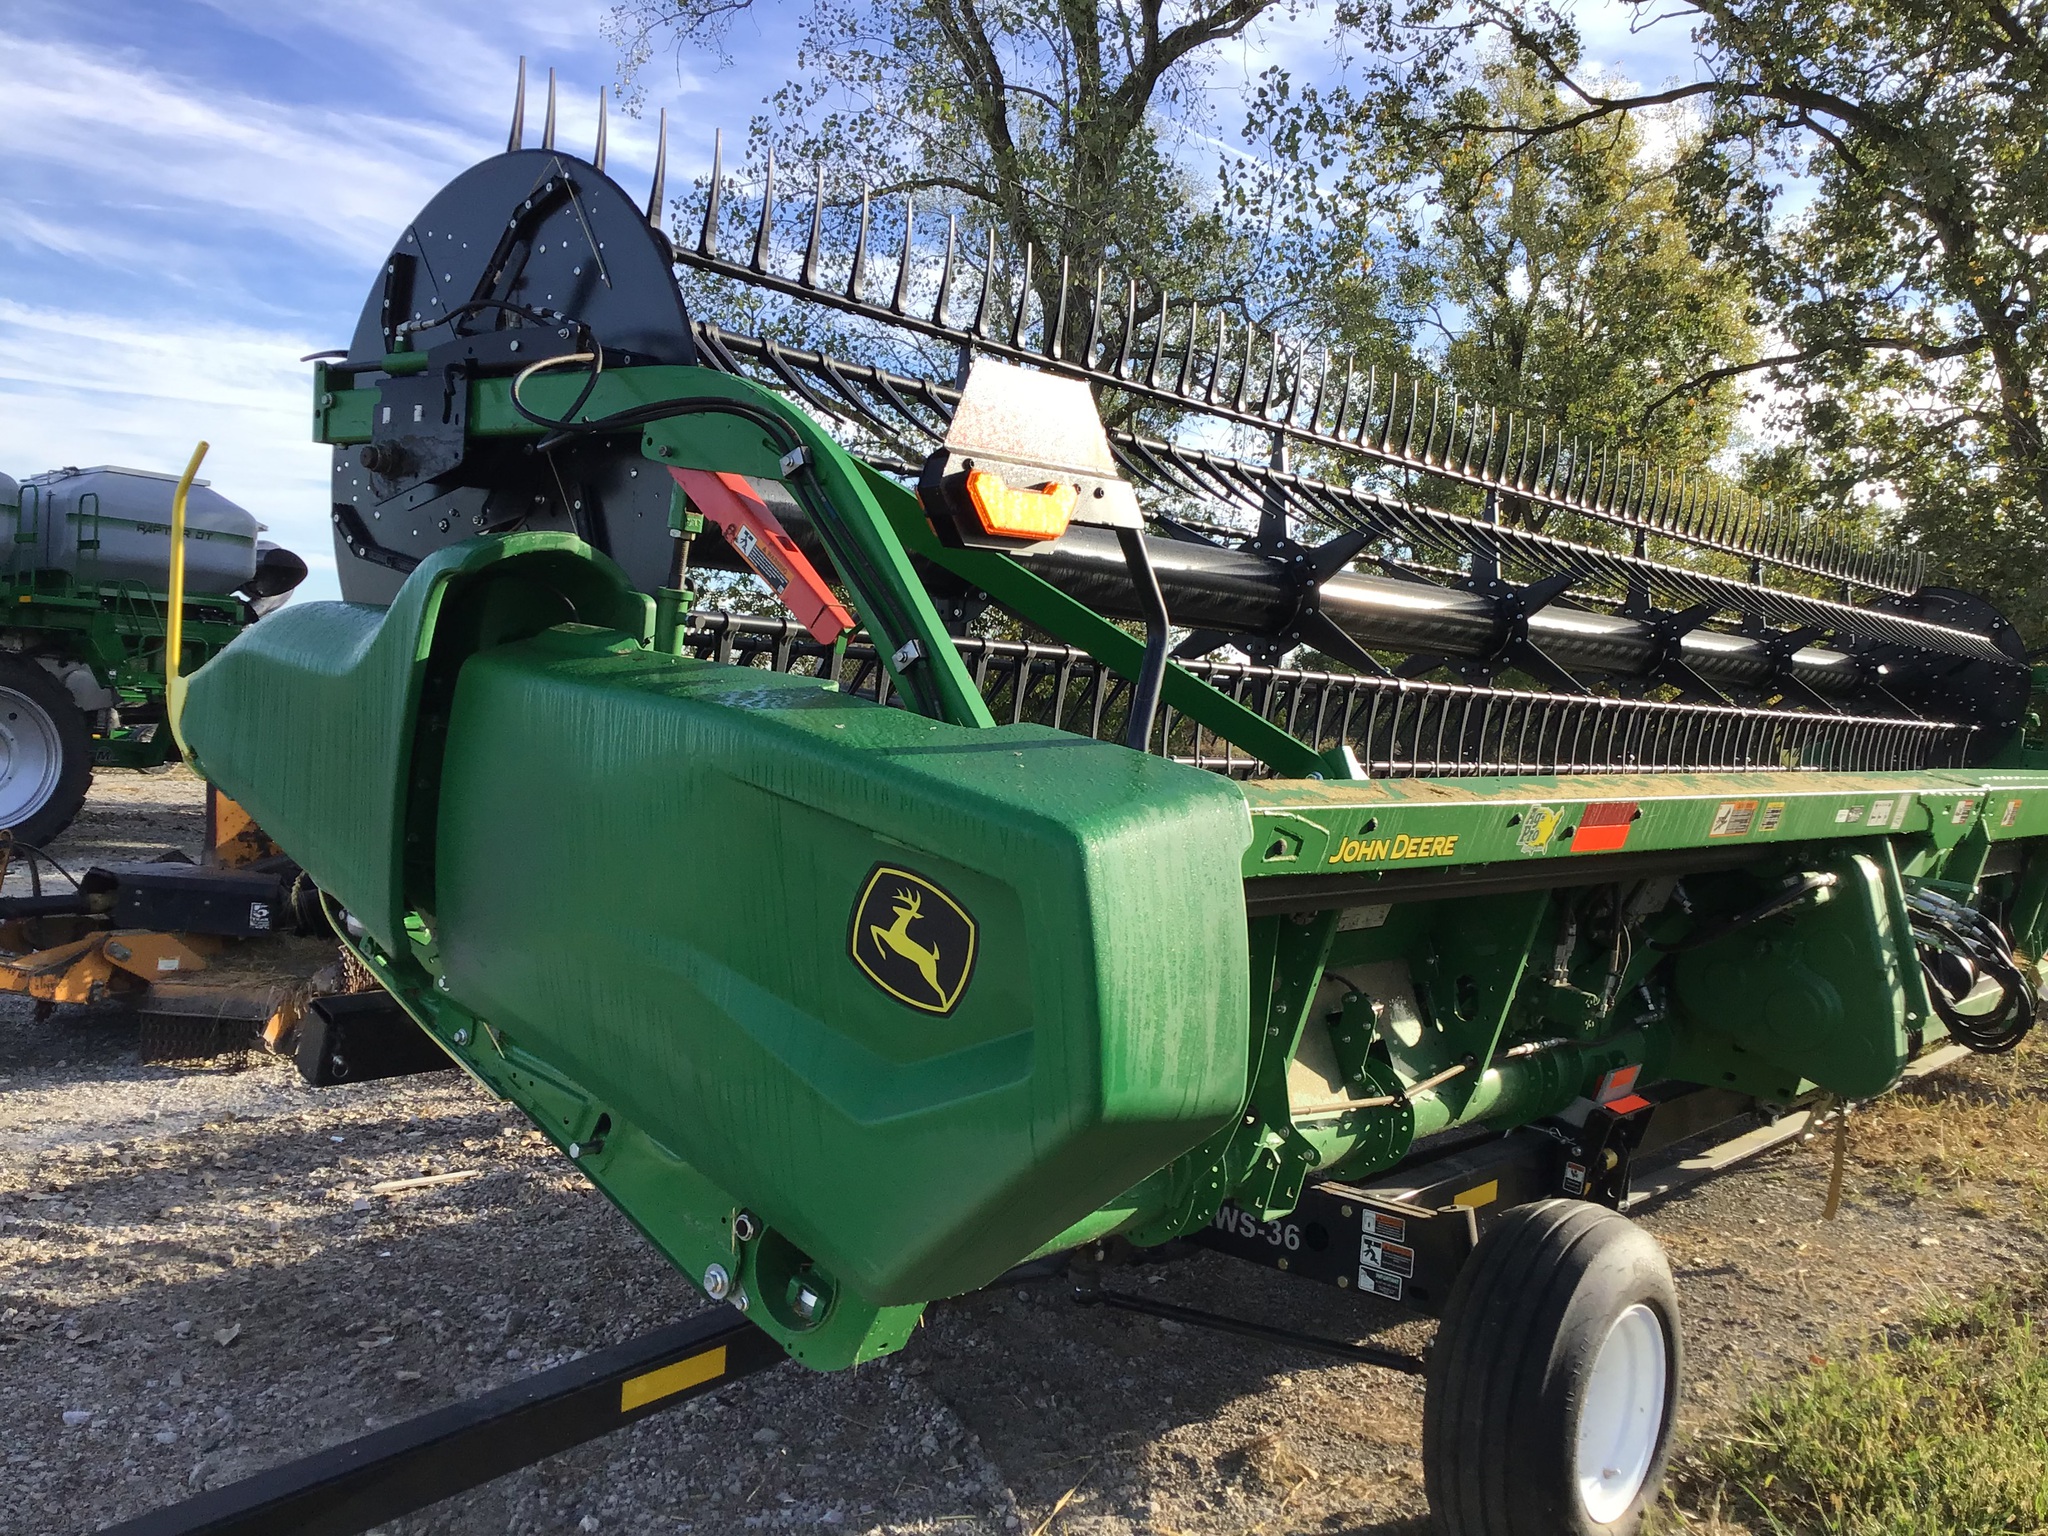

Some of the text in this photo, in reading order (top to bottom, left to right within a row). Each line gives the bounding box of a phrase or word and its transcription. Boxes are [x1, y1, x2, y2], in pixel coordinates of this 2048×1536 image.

[136, 524, 191, 538] RAPTR
[1328, 833, 1459, 864] JOHN DEERE
[1209, 1206, 1300, 1251] WS-36
